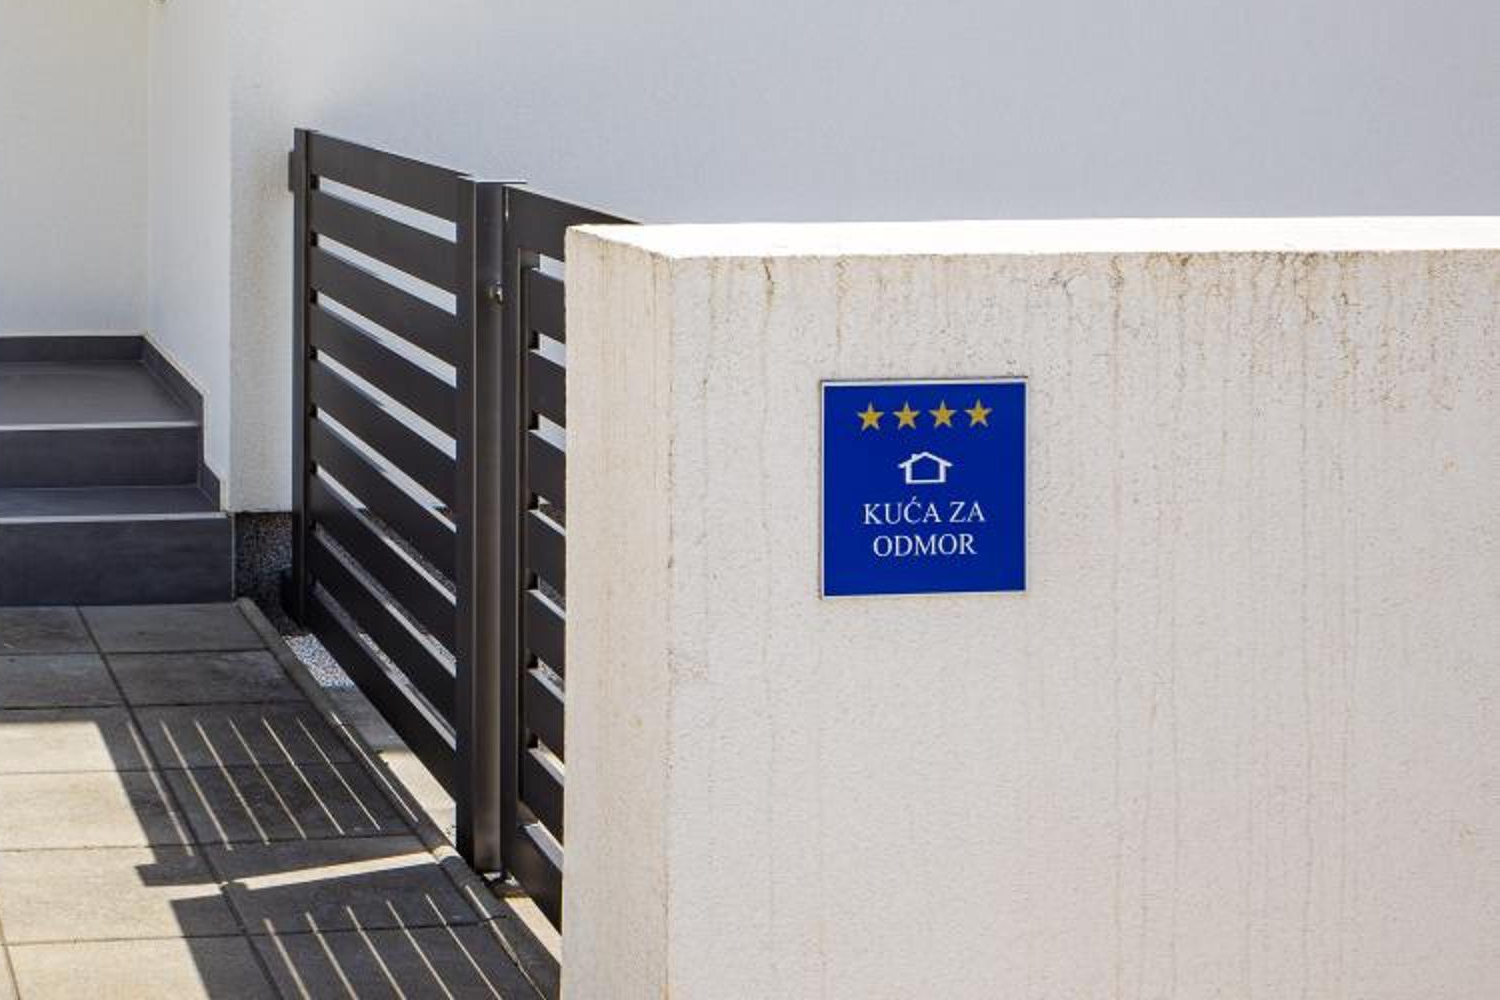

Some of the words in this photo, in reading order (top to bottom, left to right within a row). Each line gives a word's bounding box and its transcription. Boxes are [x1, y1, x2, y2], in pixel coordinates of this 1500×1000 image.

[863, 496, 942, 525] KUĆA
[949, 501, 986, 523] ZA
[873, 533, 977, 557] ODMOR
